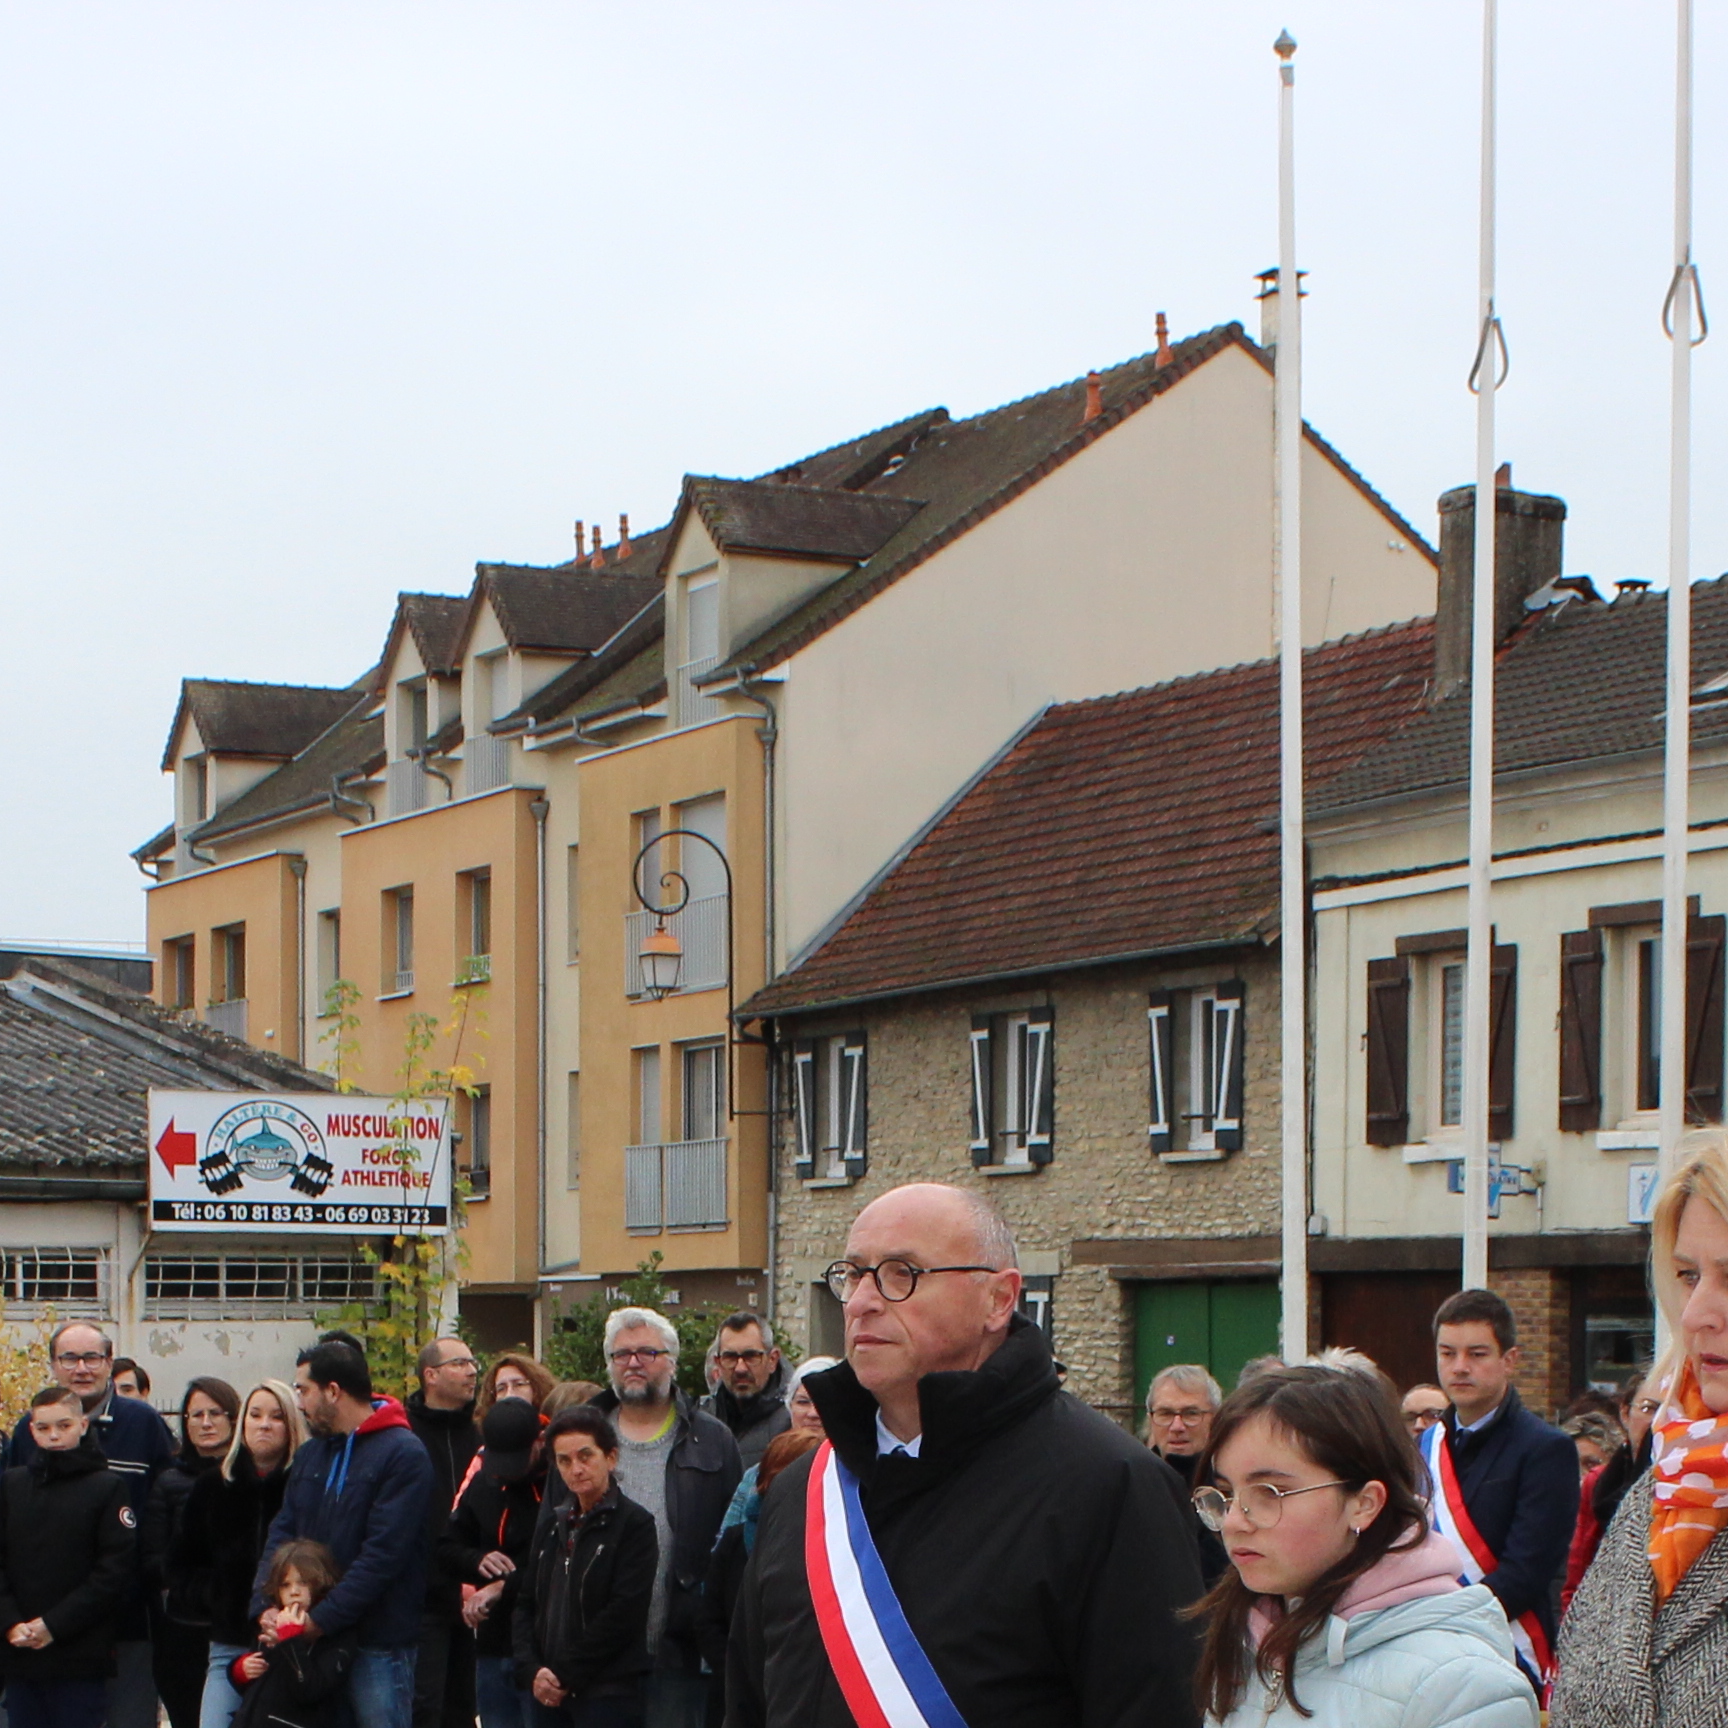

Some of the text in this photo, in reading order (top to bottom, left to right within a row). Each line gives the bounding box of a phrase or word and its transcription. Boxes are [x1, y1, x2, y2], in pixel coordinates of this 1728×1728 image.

[300, 1122, 318, 1143] GO
[204, 1204, 226, 1220] 06
[230, 1204, 248, 1220] 10
[252, 1205, 269, 1221] 81
[272, 1205, 291, 1221] 83
[294, 1205, 313, 1222] 43
[325, 1206, 345, 1222] 06
[348, 1207, 368, 1223] 69
[371, 1207, 390, 1223] 03
